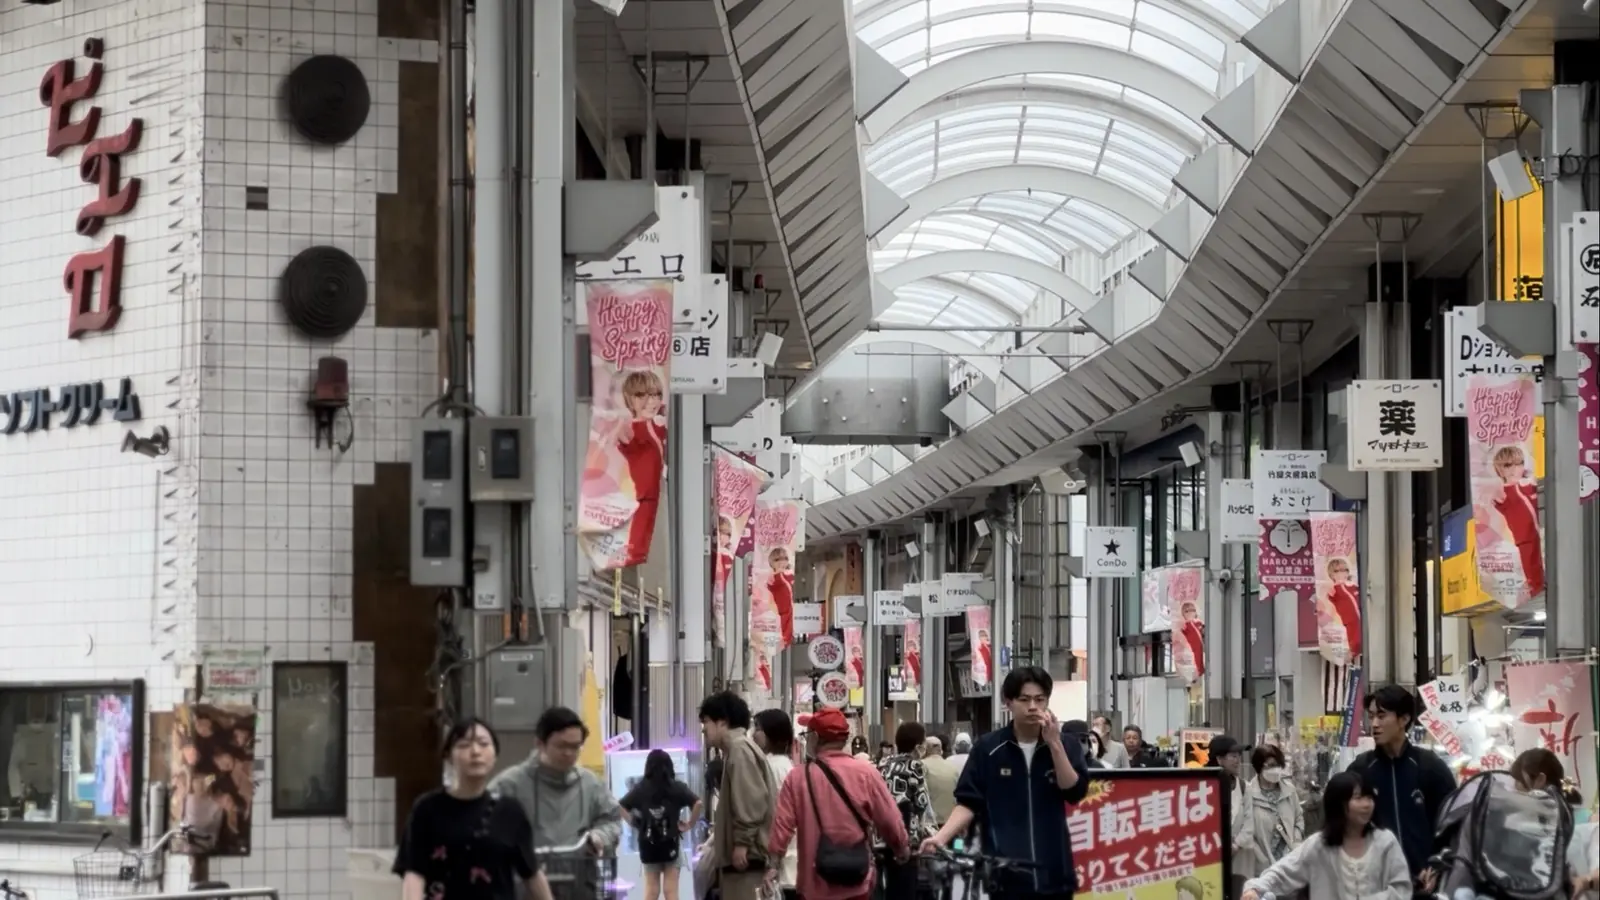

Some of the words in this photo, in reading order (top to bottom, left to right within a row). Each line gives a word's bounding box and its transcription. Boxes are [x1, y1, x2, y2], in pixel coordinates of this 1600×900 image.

[598, 295, 658, 331] Happy
[602, 326, 669, 372] Spring
[1379, 400, 1416, 436] 薬
[1474, 388, 1523, 418] Happy
[1476, 413, 1533, 450] Spring
[1271, 494, 1315, 508] おこげ
[1097, 558, 1127, 567] ConDo
[1066, 781, 1215, 853] 自転車は
